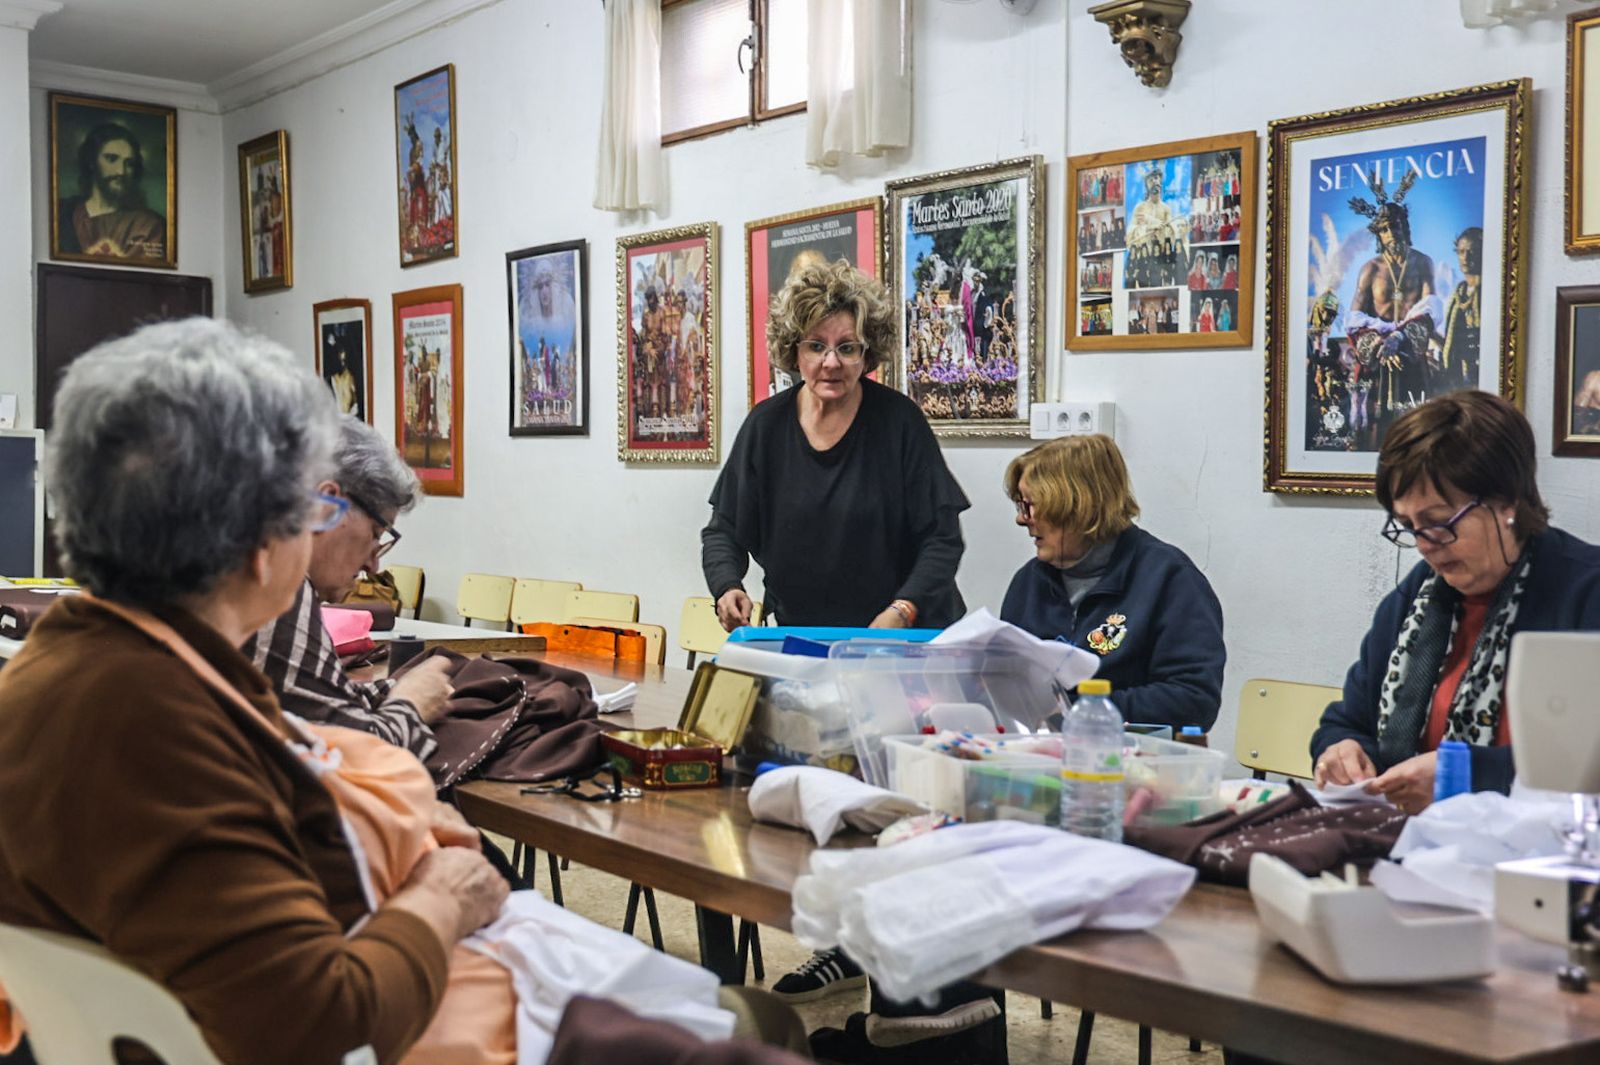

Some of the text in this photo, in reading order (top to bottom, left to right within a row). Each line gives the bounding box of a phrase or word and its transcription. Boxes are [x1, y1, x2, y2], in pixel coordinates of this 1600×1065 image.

[1319, 148, 1474, 192] SENTENCIA
[912, 198, 950, 225] Martes
[952, 191, 984, 218] Santo
[523, 399, 573, 417] SALUD
